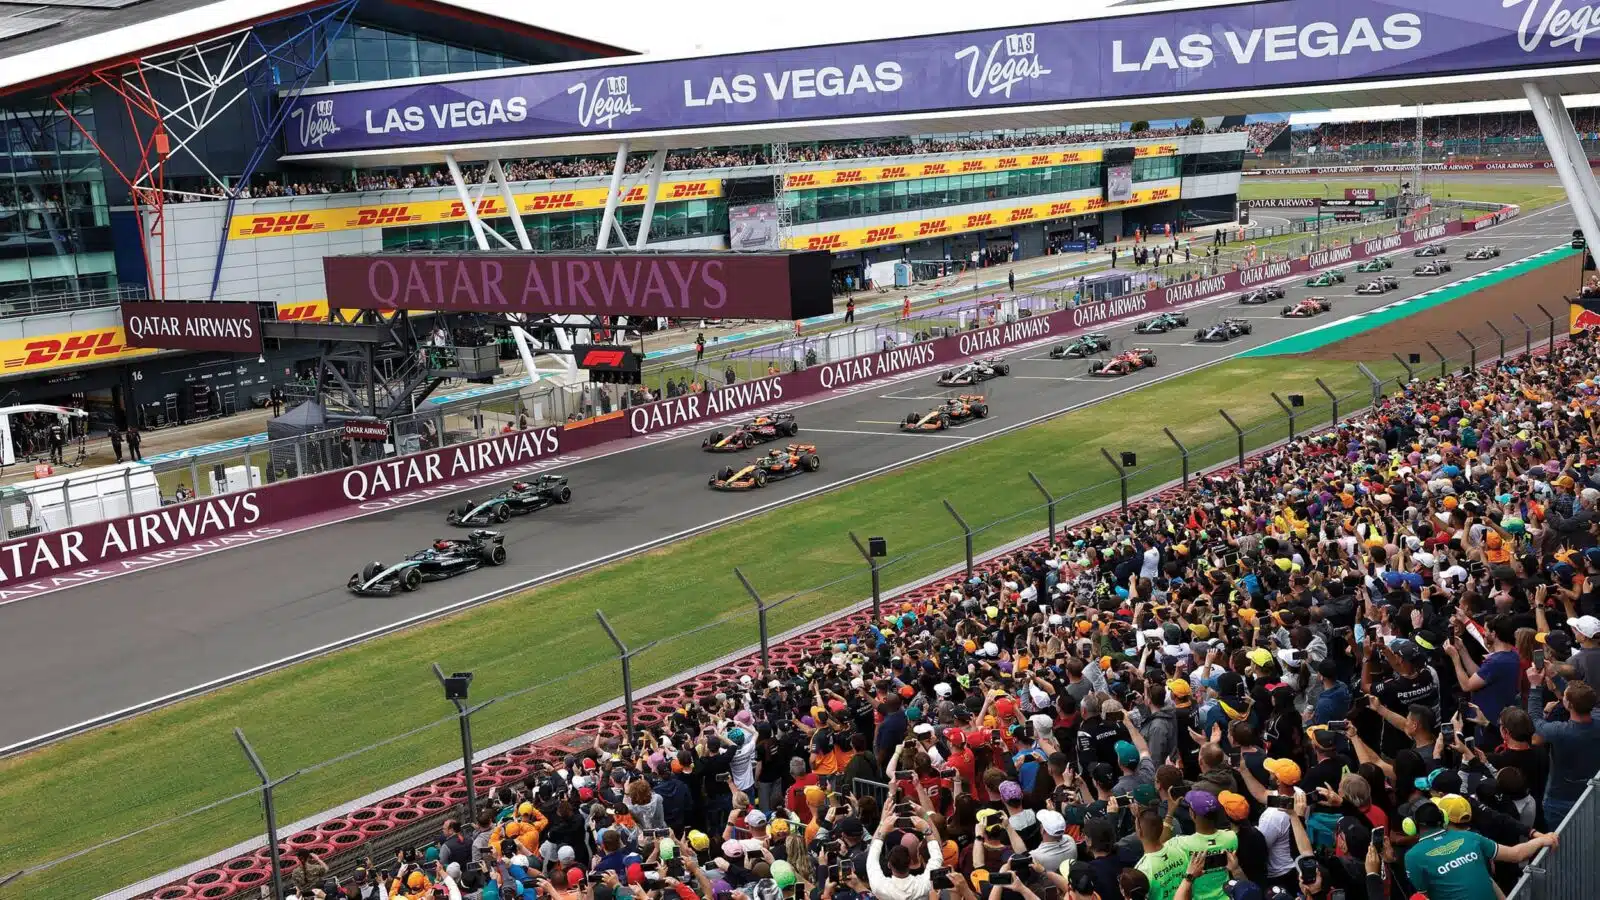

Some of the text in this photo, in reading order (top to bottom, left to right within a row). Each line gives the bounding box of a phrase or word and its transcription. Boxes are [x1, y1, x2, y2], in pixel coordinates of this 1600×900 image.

[1006, 33, 1035, 55] LAS
[1112, 13, 1422, 72] LAS VEGAS
[955, 39, 1051, 98] Vegas
[607, 76, 627, 96] LAS
[684, 61, 903, 106] LAS VEGAS
[317, 101, 332, 115] LAS
[568, 79, 641, 128] Vegas
[366, 97, 527, 133] LAS VEGAS
[292, 104, 340, 147] Vegas
[924, 164, 945, 175] DHL
[963, 161, 983, 171] DHL
[999, 158, 1017, 168] DHL
[1031, 156, 1049, 165] DHL
[788, 174, 815, 187] DHL
[836, 171, 861, 182] DHL
[882, 167, 906, 178] DHL
[674, 183, 708, 197] DHL
[533, 194, 576, 209] DHL
[1051, 203, 1073, 215] DHL
[1278, 198, 1314, 207] AIRWAYS
[252, 214, 313, 234] DHL
[358, 206, 411, 225] DHL
[968, 214, 992, 227] DHL
[1011, 208, 1034, 221] DHL
[867, 227, 897, 243] DHL
[920, 220, 946, 235] DHL
[808, 235, 841, 250] DHL
[1365, 235, 1402, 255] QATAR AIRWAYS
[1310, 246, 1352, 268] QATAR AIRWAYS
[1240, 260, 1291, 286] QATAR AIRWAYS
[368, 260, 728, 309] QATAR AIRWAYS
[1166, 276, 1226, 304] QATAR AIRWAYS
[1074, 294, 1147, 326] QATAR AIRWAYS
[130, 316, 253, 339] QATAR AIRWAYS
[960, 317, 1050, 355] QATAR AIRWAYS
[24, 332, 123, 365] DHL
[583, 351, 625, 367] F1
[820, 357, 872, 388] QATAR
[876, 342, 935, 374] AIRWAYS
[132, 371, 143, 381] 16
[631, 397, 702, 434] QATAR
[706, 376, 783, 415] AIRWAYS
[364, 428, 386, 436] AIRWAYS
[343, 427, 559, 501] QATAR AIRWAYS
[359, 484, 463, 509] QATAR
[101, 493, 260, 557] AIRWAYS
[121, 527, 283, 568] AIRWAYS
[1437, 852, 1478, 874] aramco
